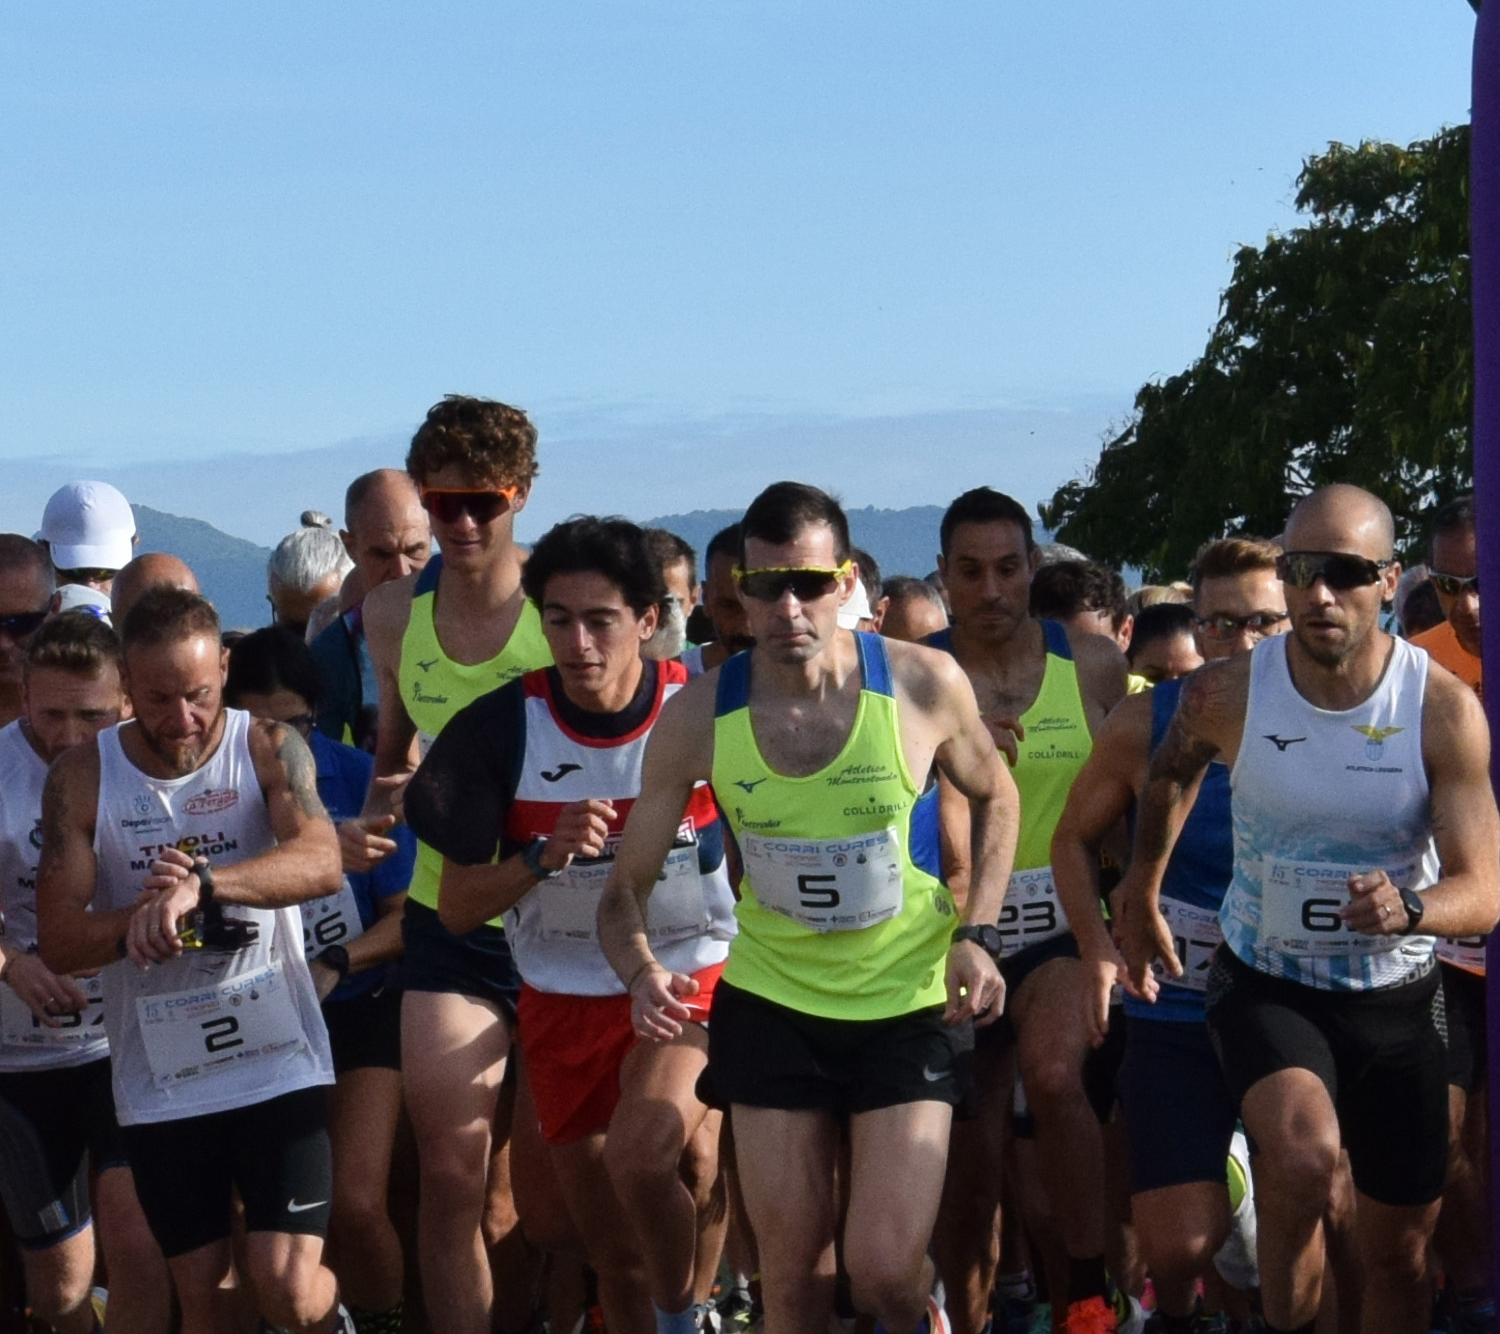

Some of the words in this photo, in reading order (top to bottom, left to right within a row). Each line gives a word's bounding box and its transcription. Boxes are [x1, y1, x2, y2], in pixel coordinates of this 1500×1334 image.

[763, 842, 820, 854] CORRI
[825, 836, 889, 854] CURES
[1294, 867, 1350, 879] CORRI
[797, 874, 841, 908] 5
[165, 991, 217, 1008] CORRI
[221, 969, 276, 996] CURES
[201, 1016, 244, 1053] 2
